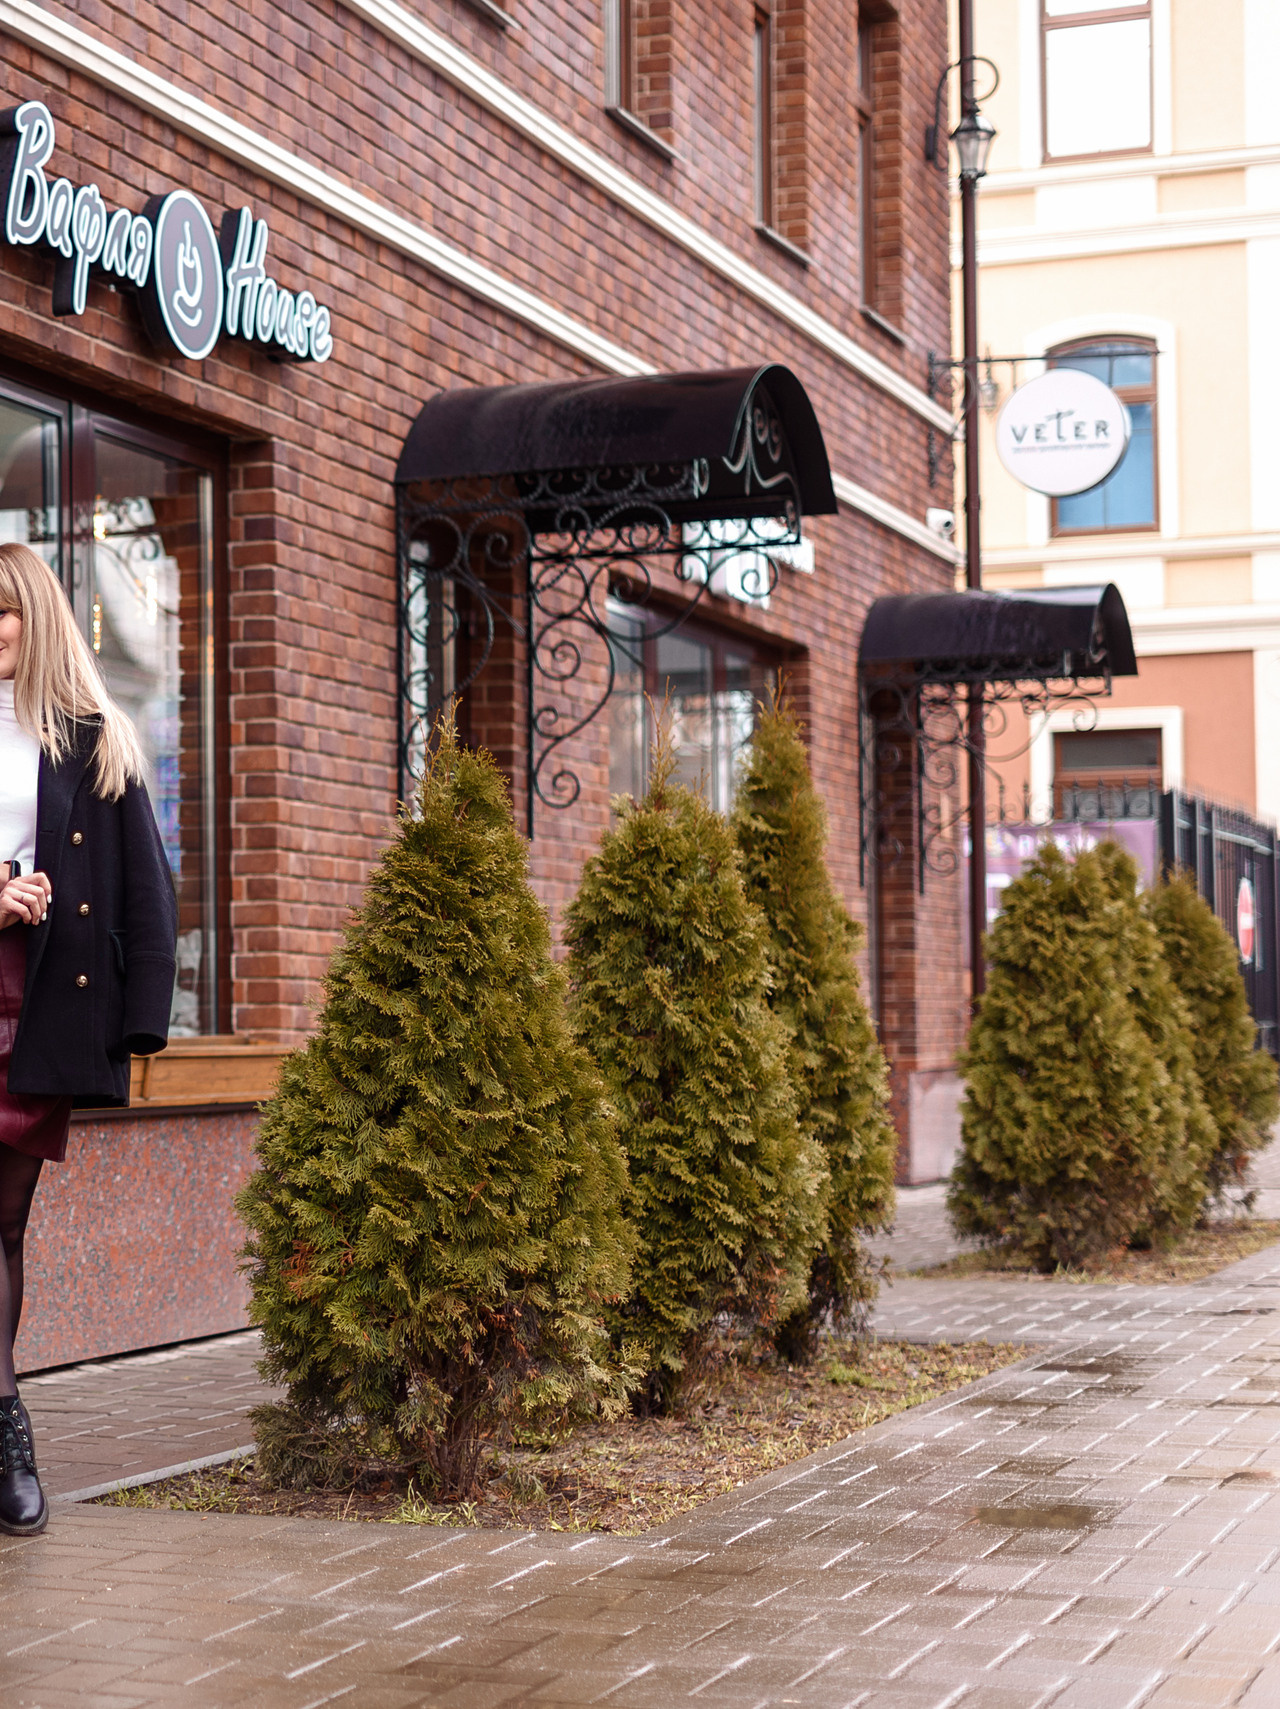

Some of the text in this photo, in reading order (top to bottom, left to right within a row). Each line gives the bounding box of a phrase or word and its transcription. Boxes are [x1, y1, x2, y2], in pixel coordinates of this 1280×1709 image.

[6, 100, 153, 315] Вафля
[226, 206, 333, 363] House
[1010, 409, 1109, 443] VETER
